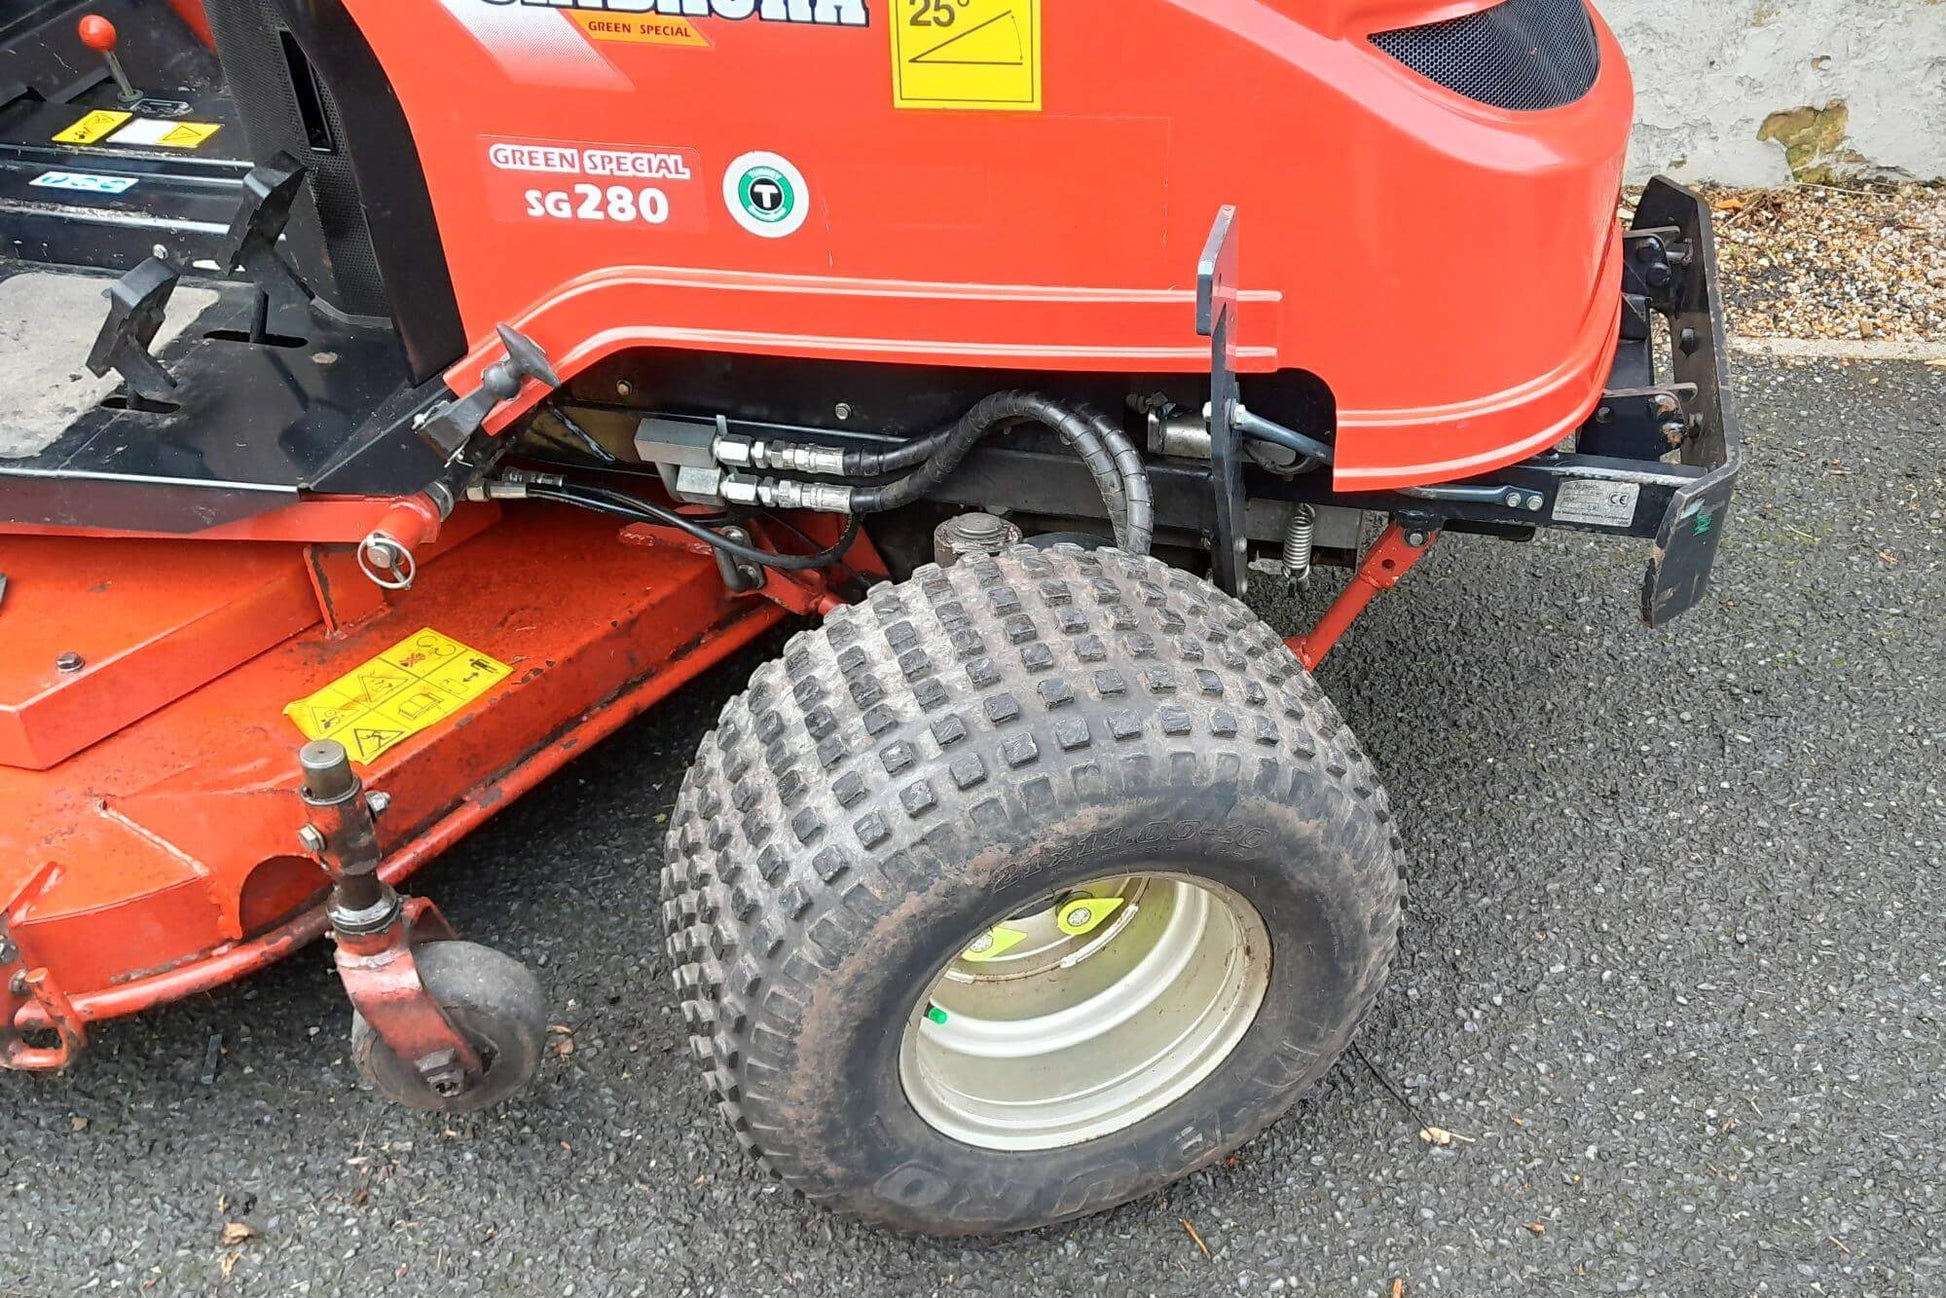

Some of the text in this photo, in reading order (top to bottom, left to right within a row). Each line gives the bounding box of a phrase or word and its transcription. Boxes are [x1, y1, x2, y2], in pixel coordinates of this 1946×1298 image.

[587, 20, 692, 38] GREEN SPECIAL
[491, 145, 690, 178] GREEN SPECIAL
[524, 183, 670, 224] SG280
[753, 184, 779, 208] T
